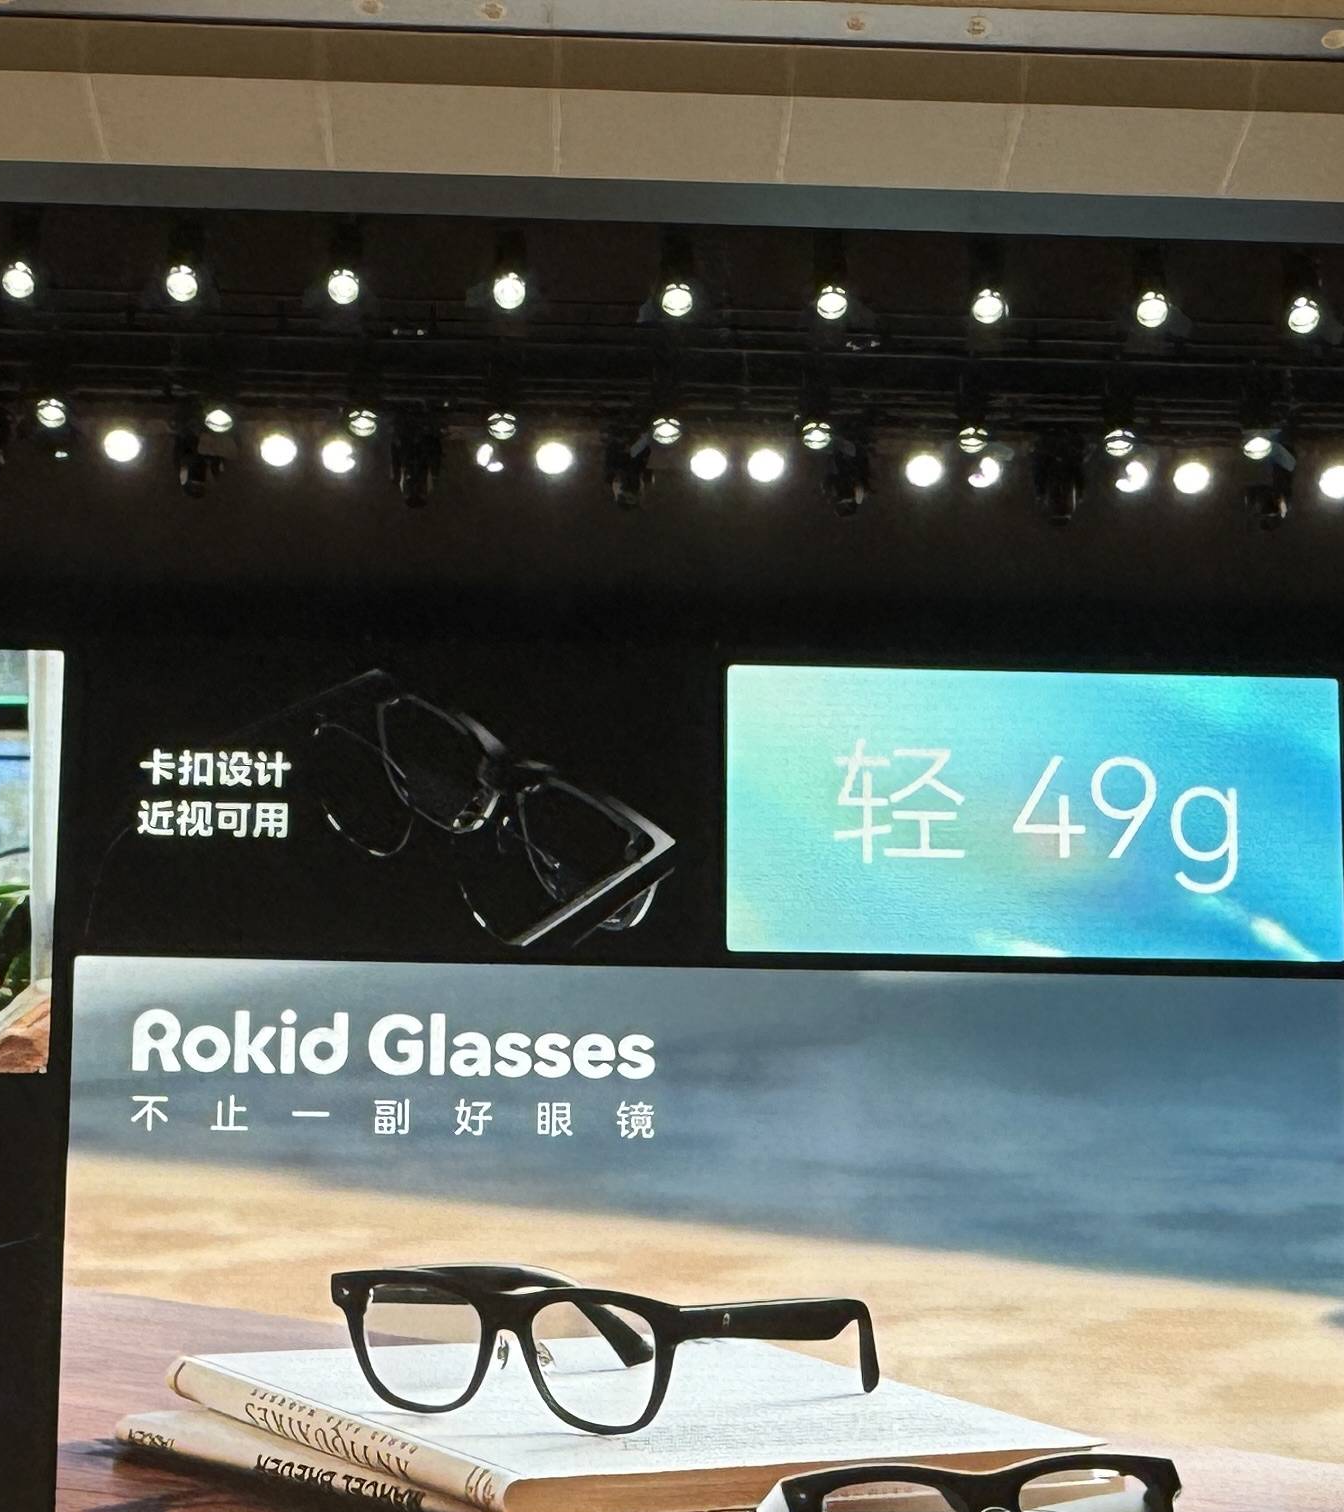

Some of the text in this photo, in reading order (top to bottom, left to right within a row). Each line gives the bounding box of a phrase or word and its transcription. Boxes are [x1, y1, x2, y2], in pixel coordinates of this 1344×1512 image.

[140, 749, 291, 787] 卡扣设计
[137, 800, 288, 838] 近视可用
[835, 739, 1239, 894] 轻 49g
[132, 1009, 655, 1079] Rokid Glasses
[131, 1095, 654, 1138] 不止一副好眼镜
